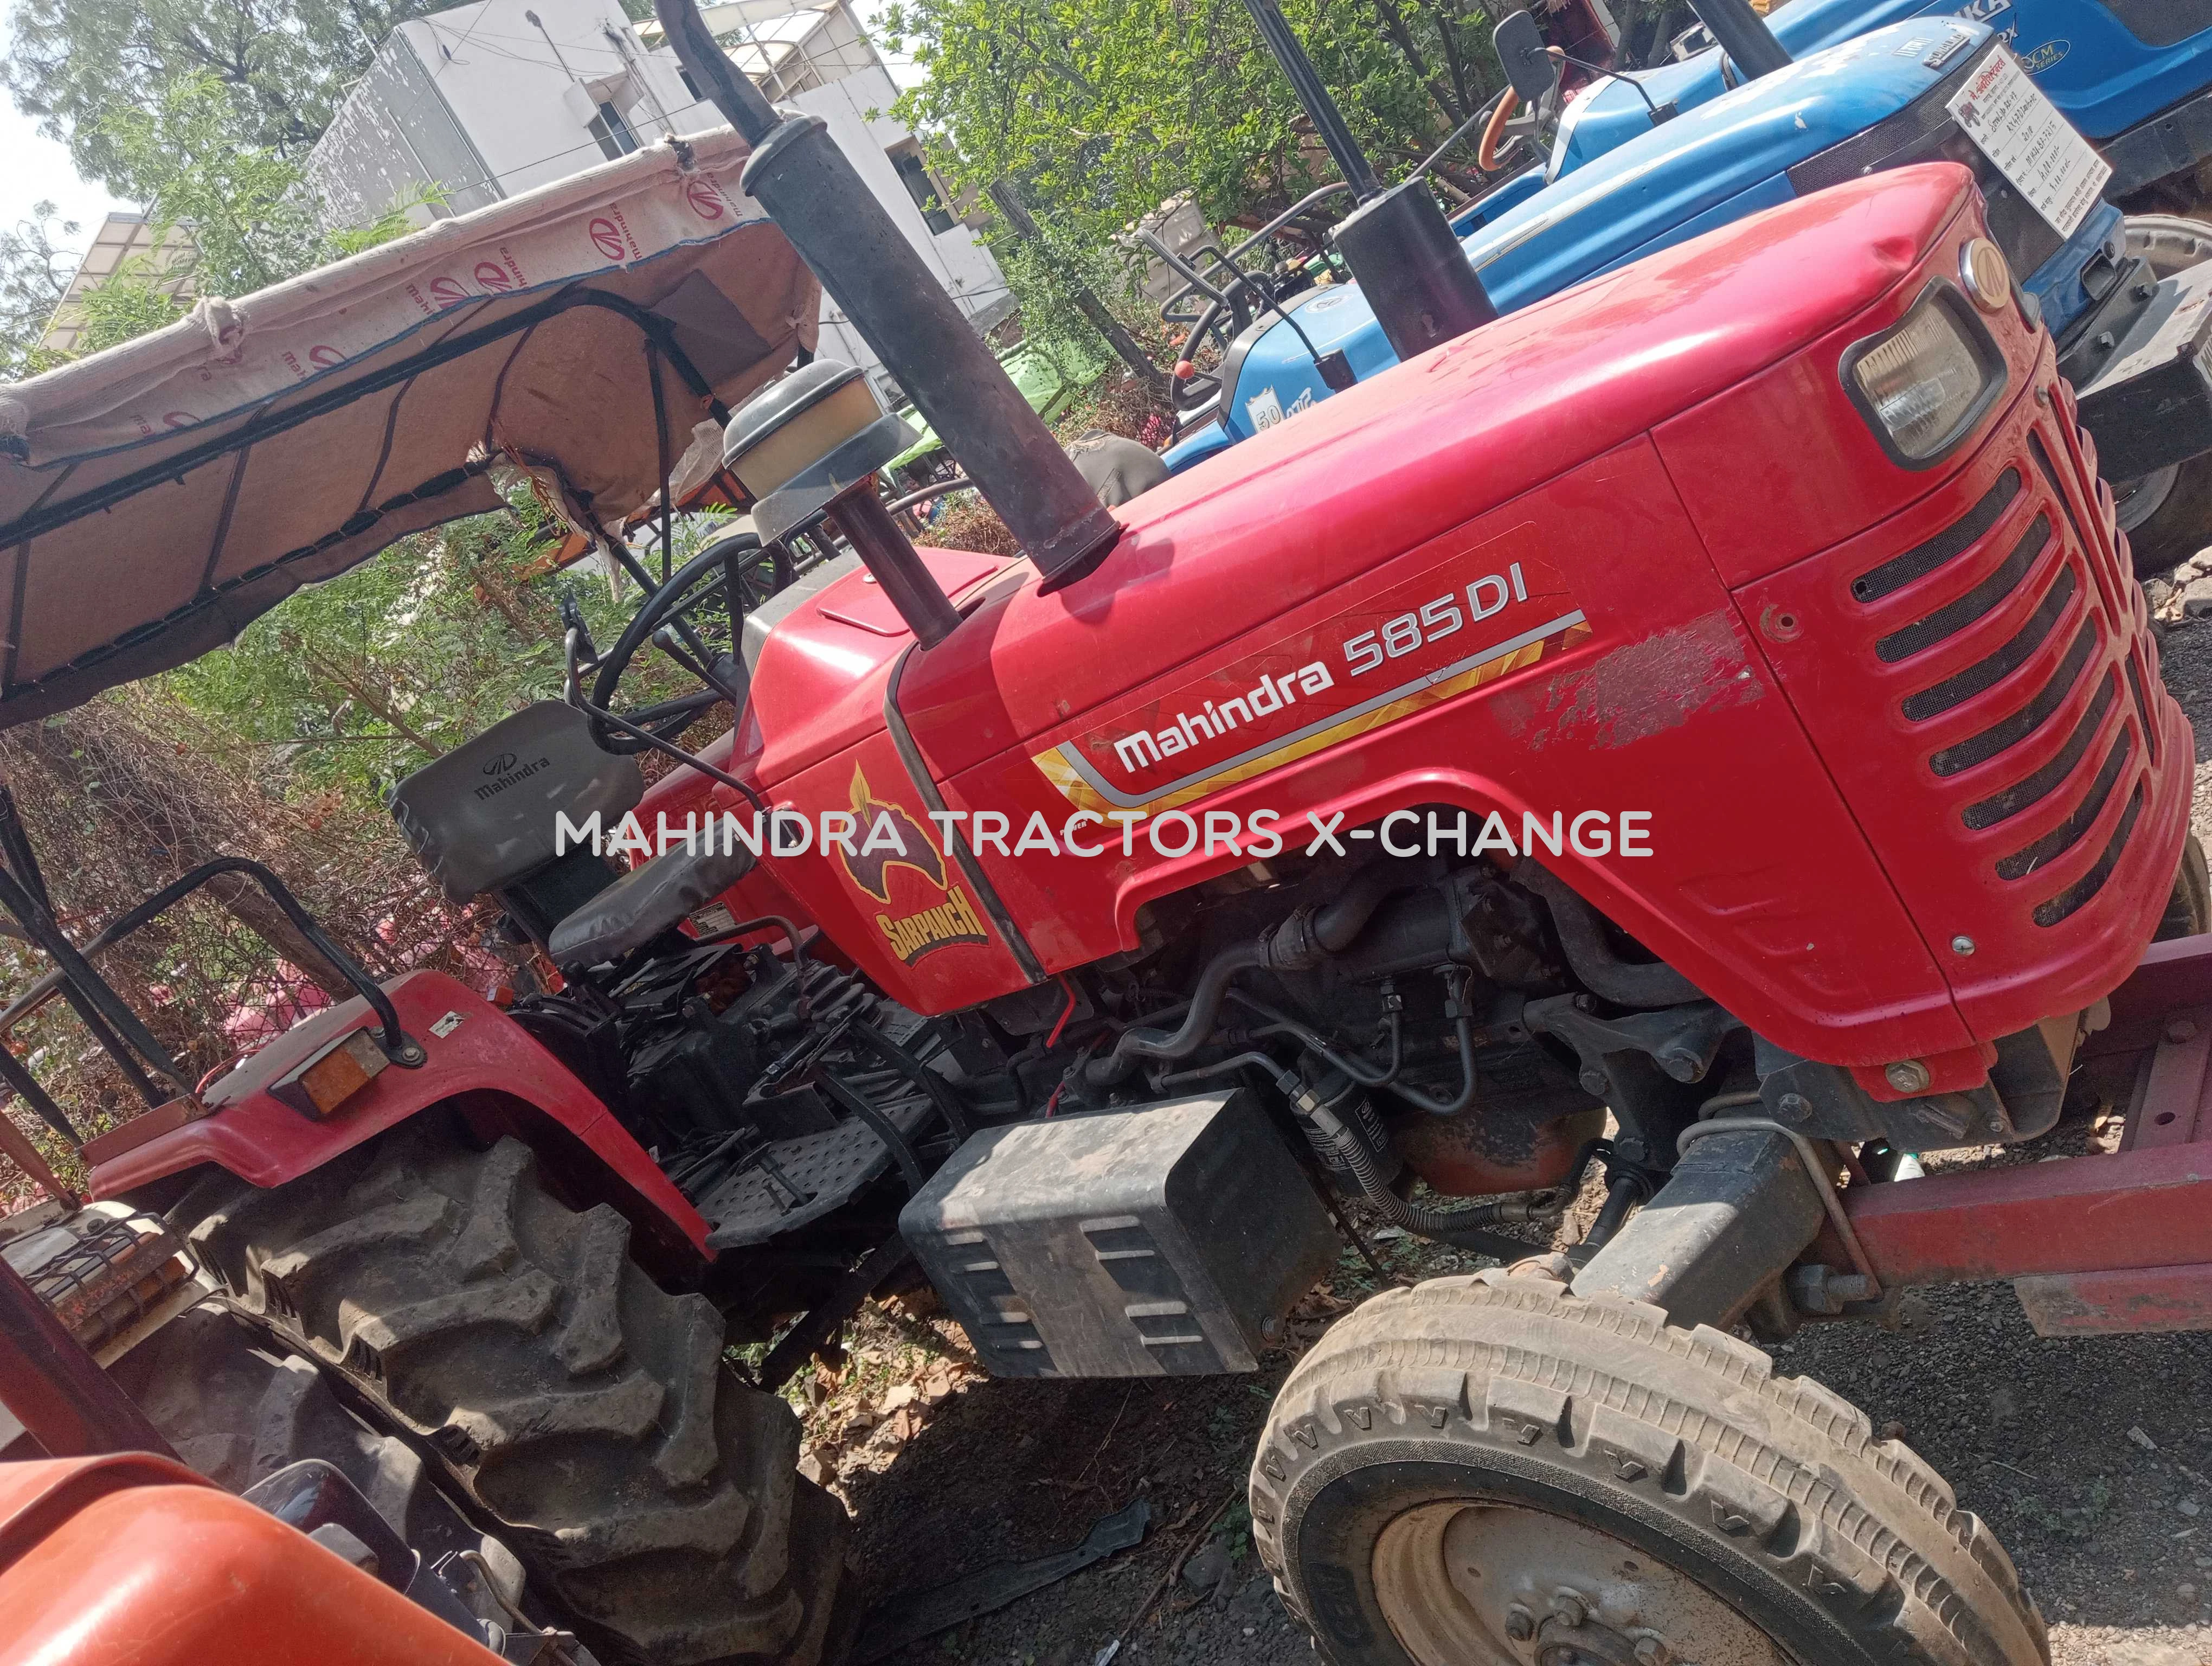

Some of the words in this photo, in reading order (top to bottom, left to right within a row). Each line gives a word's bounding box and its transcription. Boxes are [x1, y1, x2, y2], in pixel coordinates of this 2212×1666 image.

[707, 172, 743, 217] mahindra
[609, 202, 642, 260] mahindra
[1256, 405, 1281, 430] 50
[1114, 661, 1335, 773] Mahindra
[1343, 593, 1463, 677] 585
[1465, 562, 1530, 624] DI
[473, 756, 550, 801] Mahindra
[1059, 821, 1088, 836] PWER
[876, 885, 987, 961] SARPANCH
